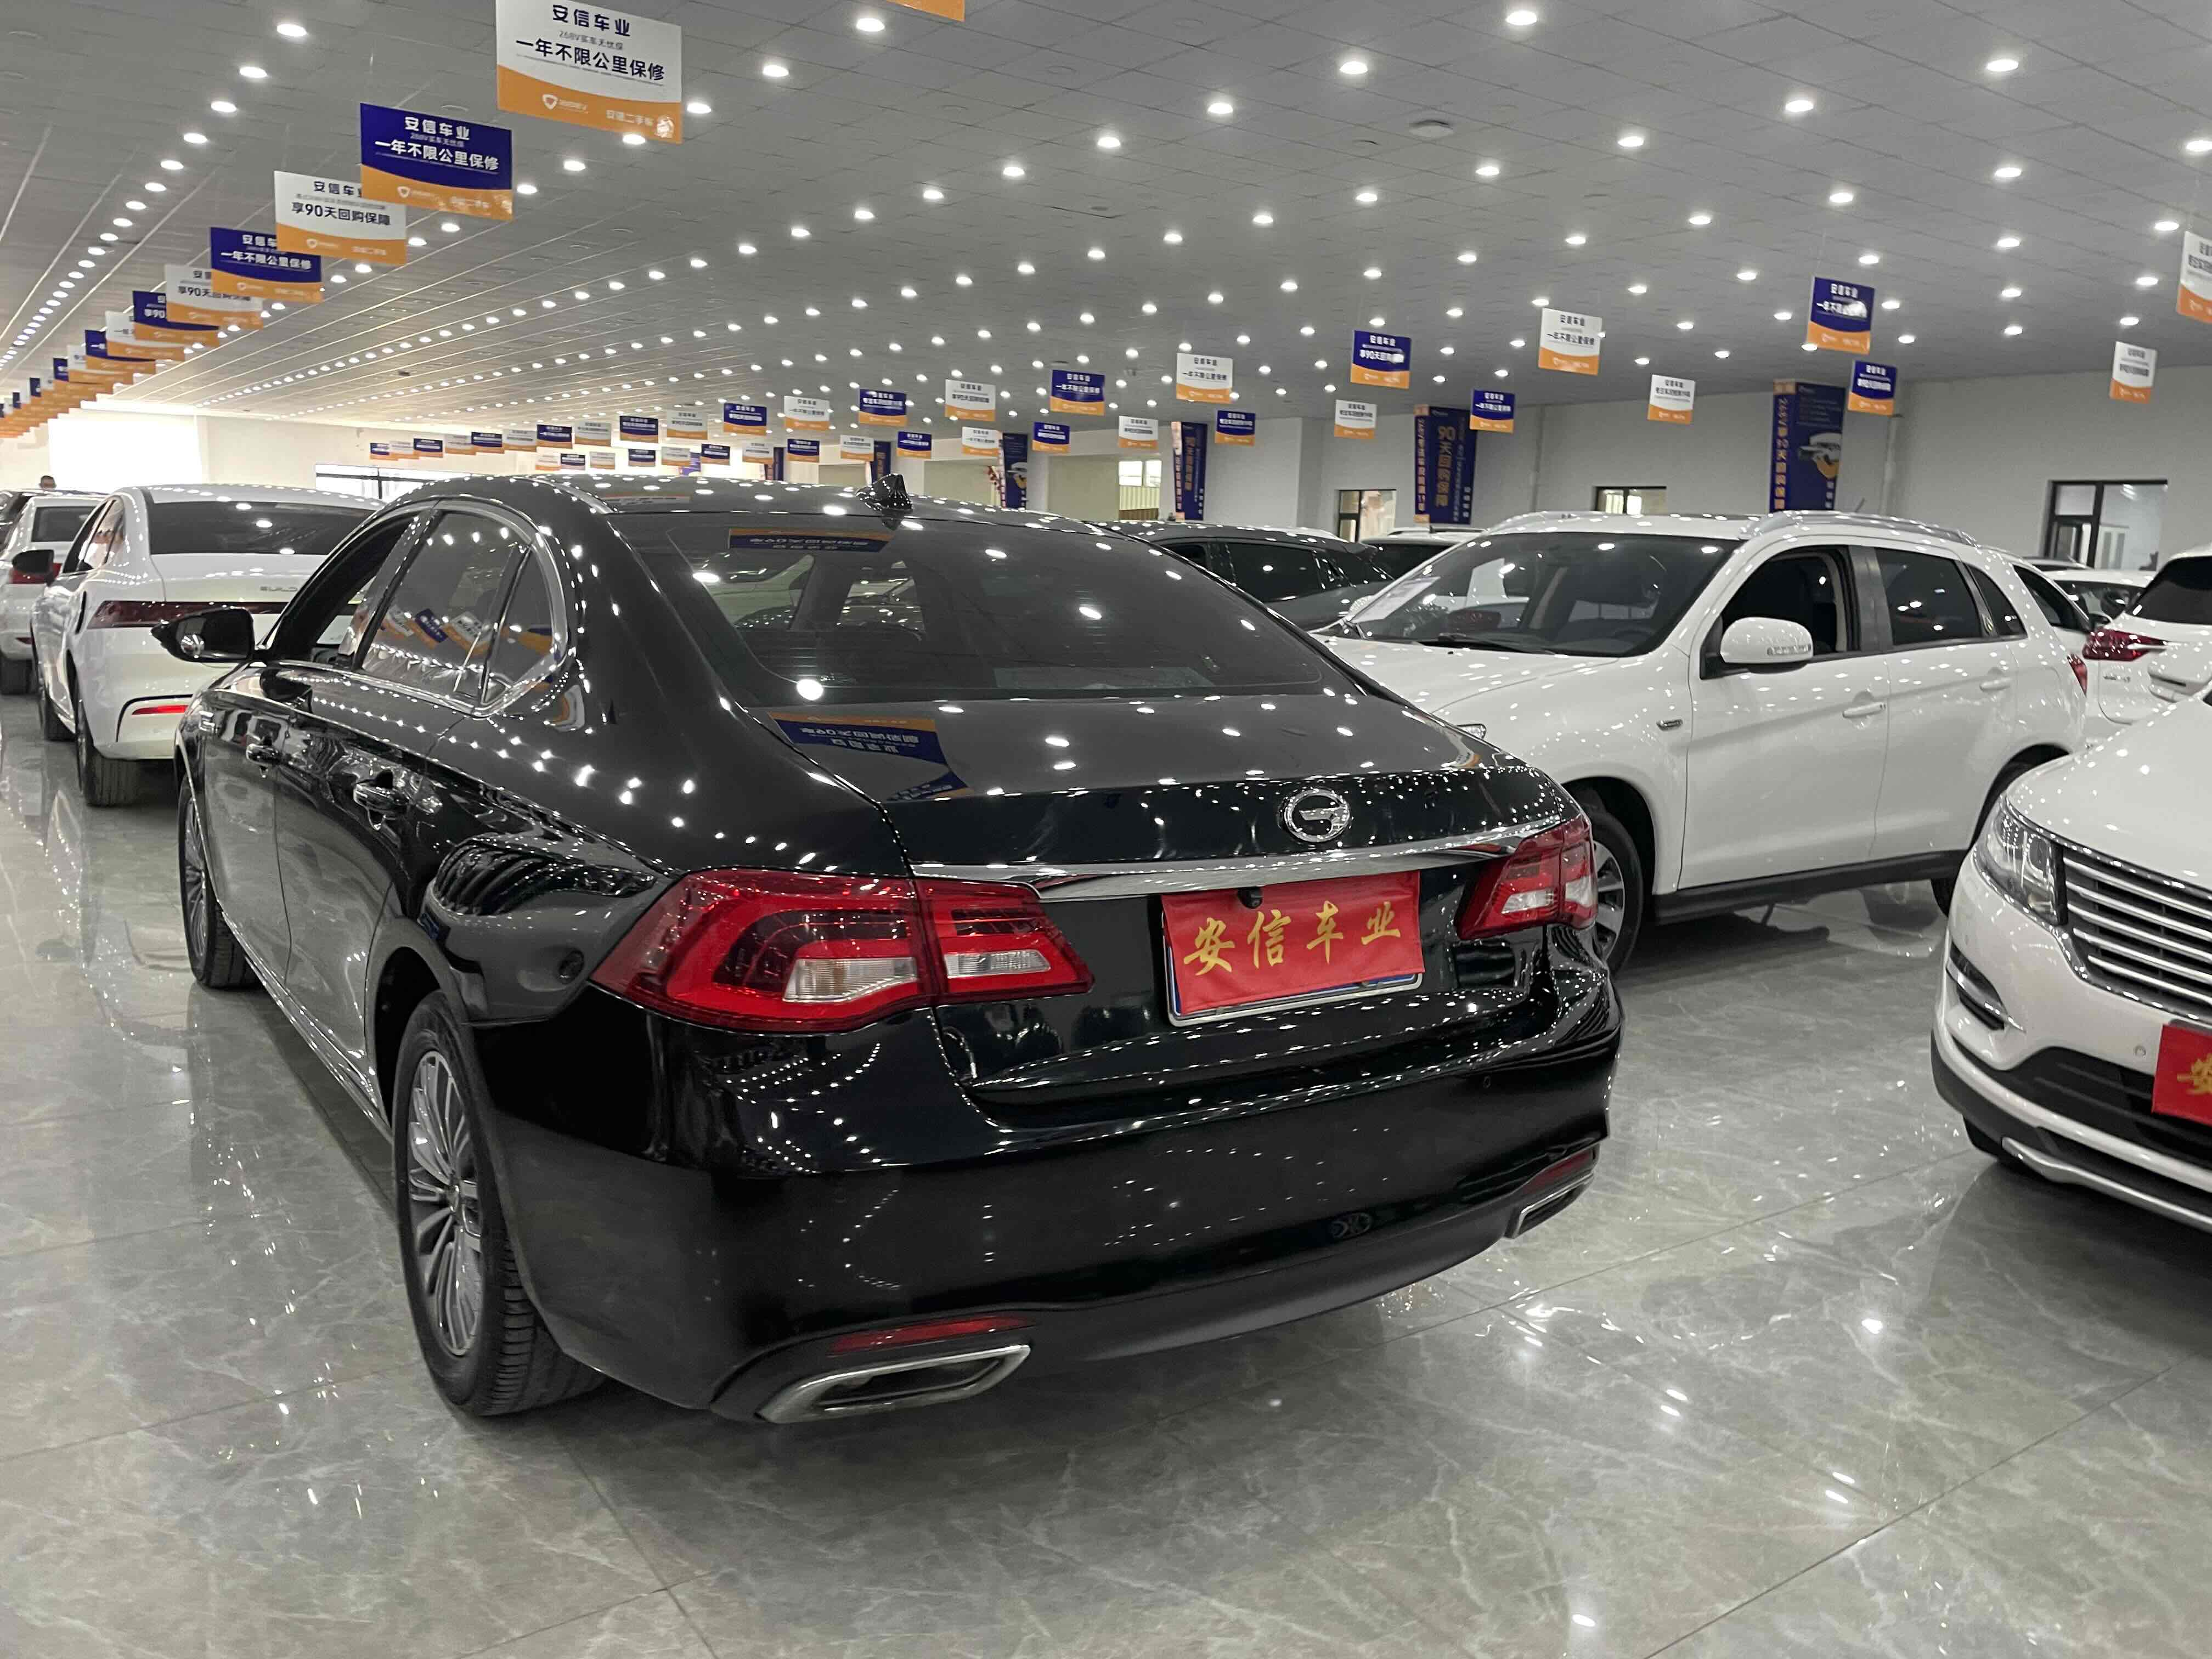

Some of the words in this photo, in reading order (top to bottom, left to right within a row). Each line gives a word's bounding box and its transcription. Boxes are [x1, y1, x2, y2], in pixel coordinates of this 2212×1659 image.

[552, 4, 630, 37] 安信车业
[516, 38, 664, 81] 一年不限公里保修
[405, 116, 470, 140] 安信车业
[375, 139, 499, 171] 一年不限公里保修
[292, 201, 391, 225] 享90天回购保障
[242, 234, 277, 247] 安信车
[1183, 900, 1401, 976] 安信车业
